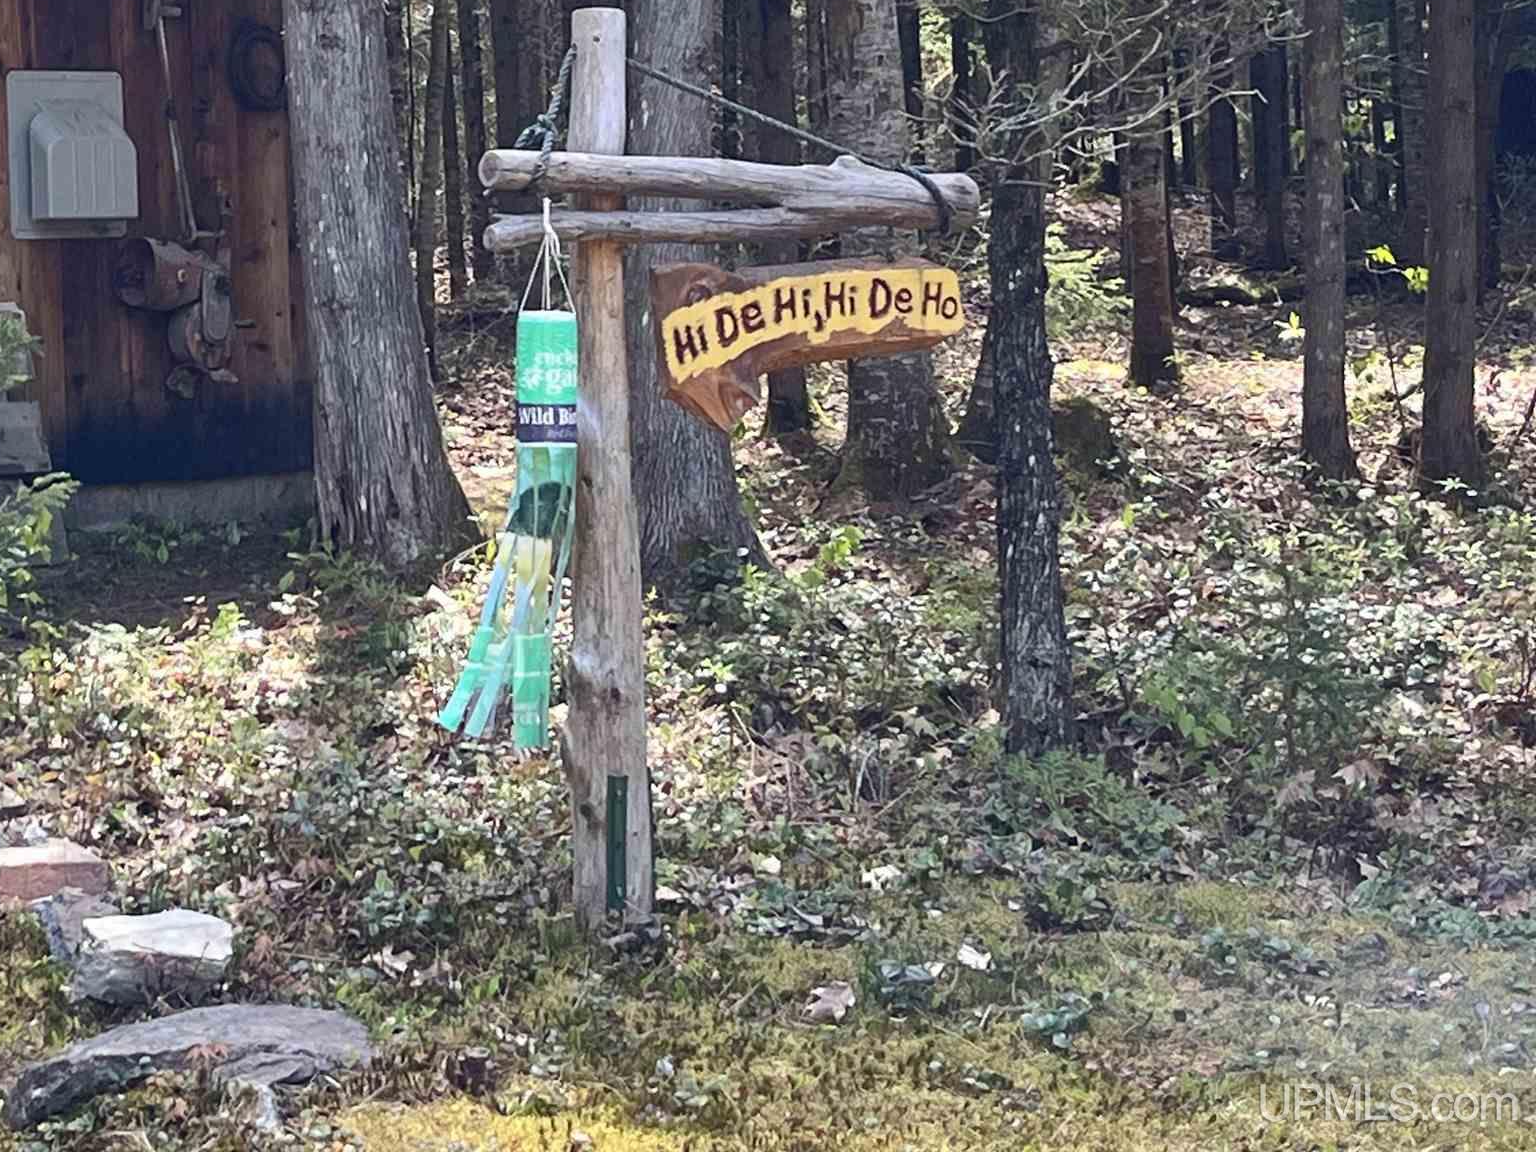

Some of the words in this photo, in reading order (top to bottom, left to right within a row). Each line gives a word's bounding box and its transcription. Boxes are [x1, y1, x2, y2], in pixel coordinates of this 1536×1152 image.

[672, 323, 708, 366] Hi
[715, 302, 767, 347] De
[869, 277, 914, 319] De
[922, 281, 958, 319] Ho
[518, 406, 555, 425] Wild
